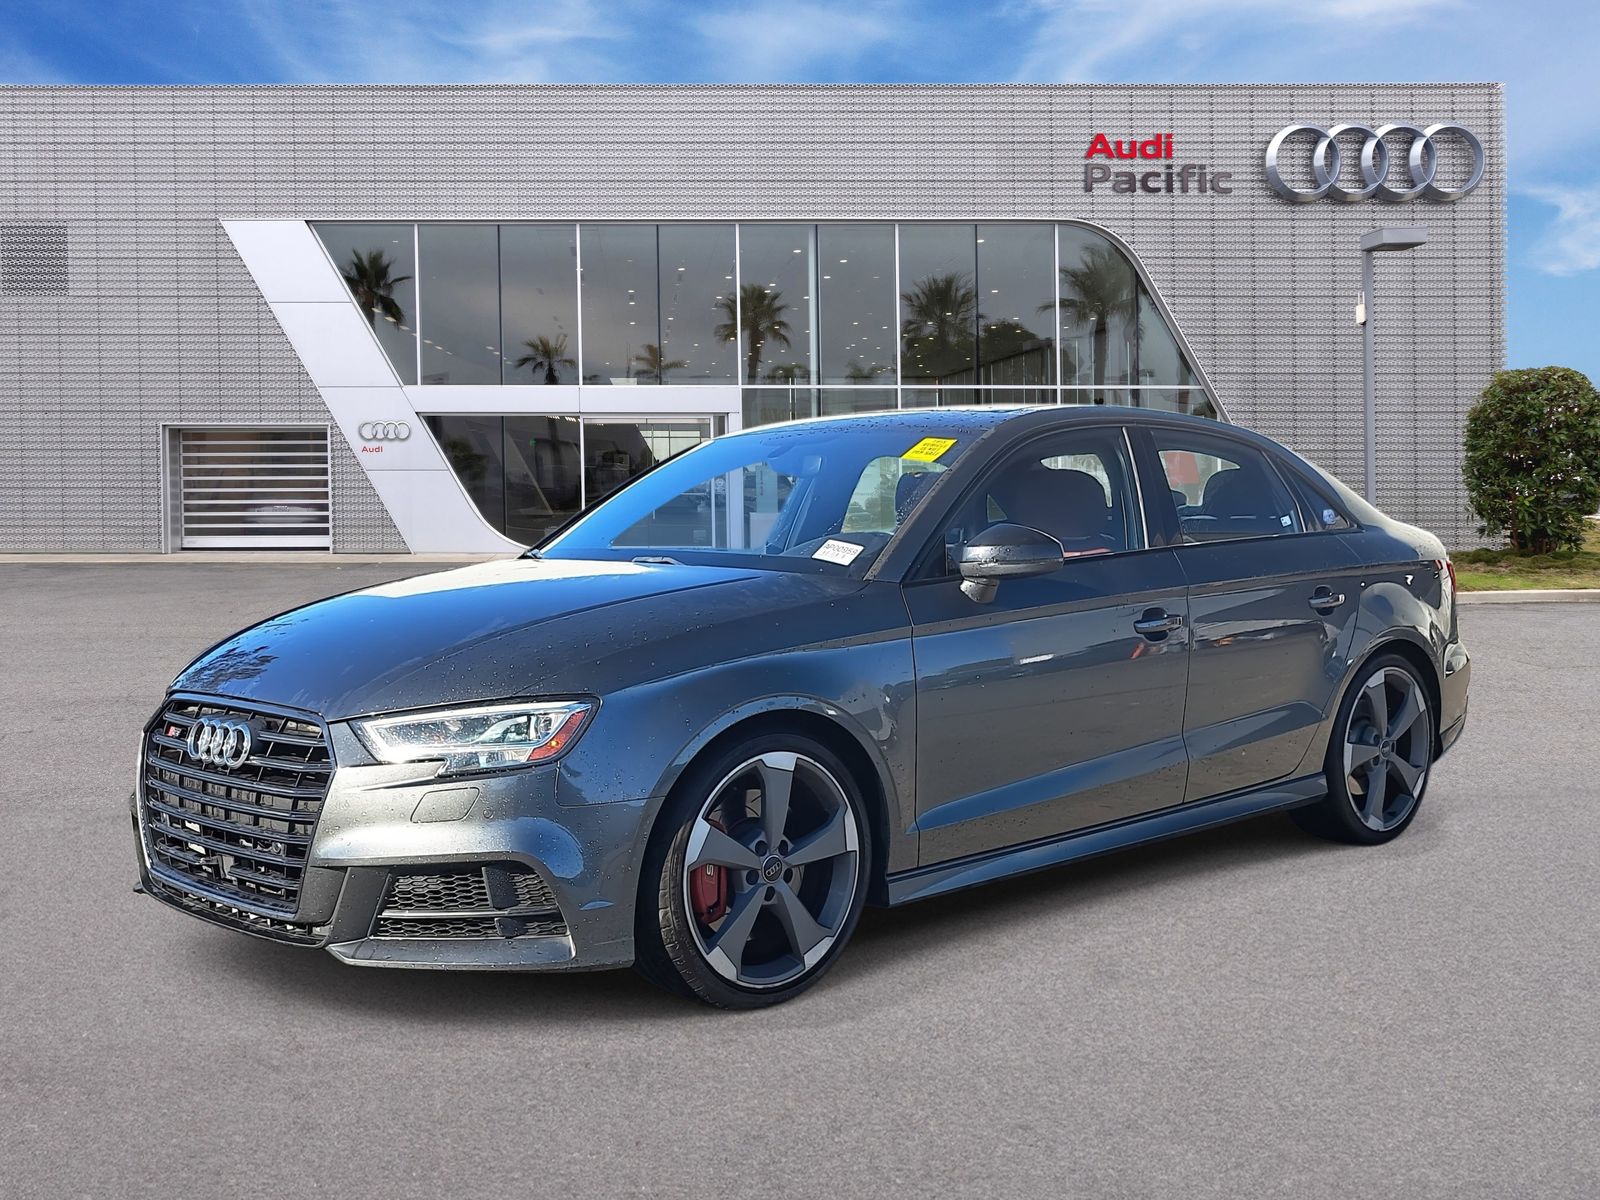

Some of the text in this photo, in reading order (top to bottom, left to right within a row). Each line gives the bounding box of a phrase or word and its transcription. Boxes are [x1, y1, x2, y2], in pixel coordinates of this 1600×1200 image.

[1085, 133, 1173, 159] Audi
[1084, 163, 1233, 193] Pacific
[361, 445, 383, 453] Audi
